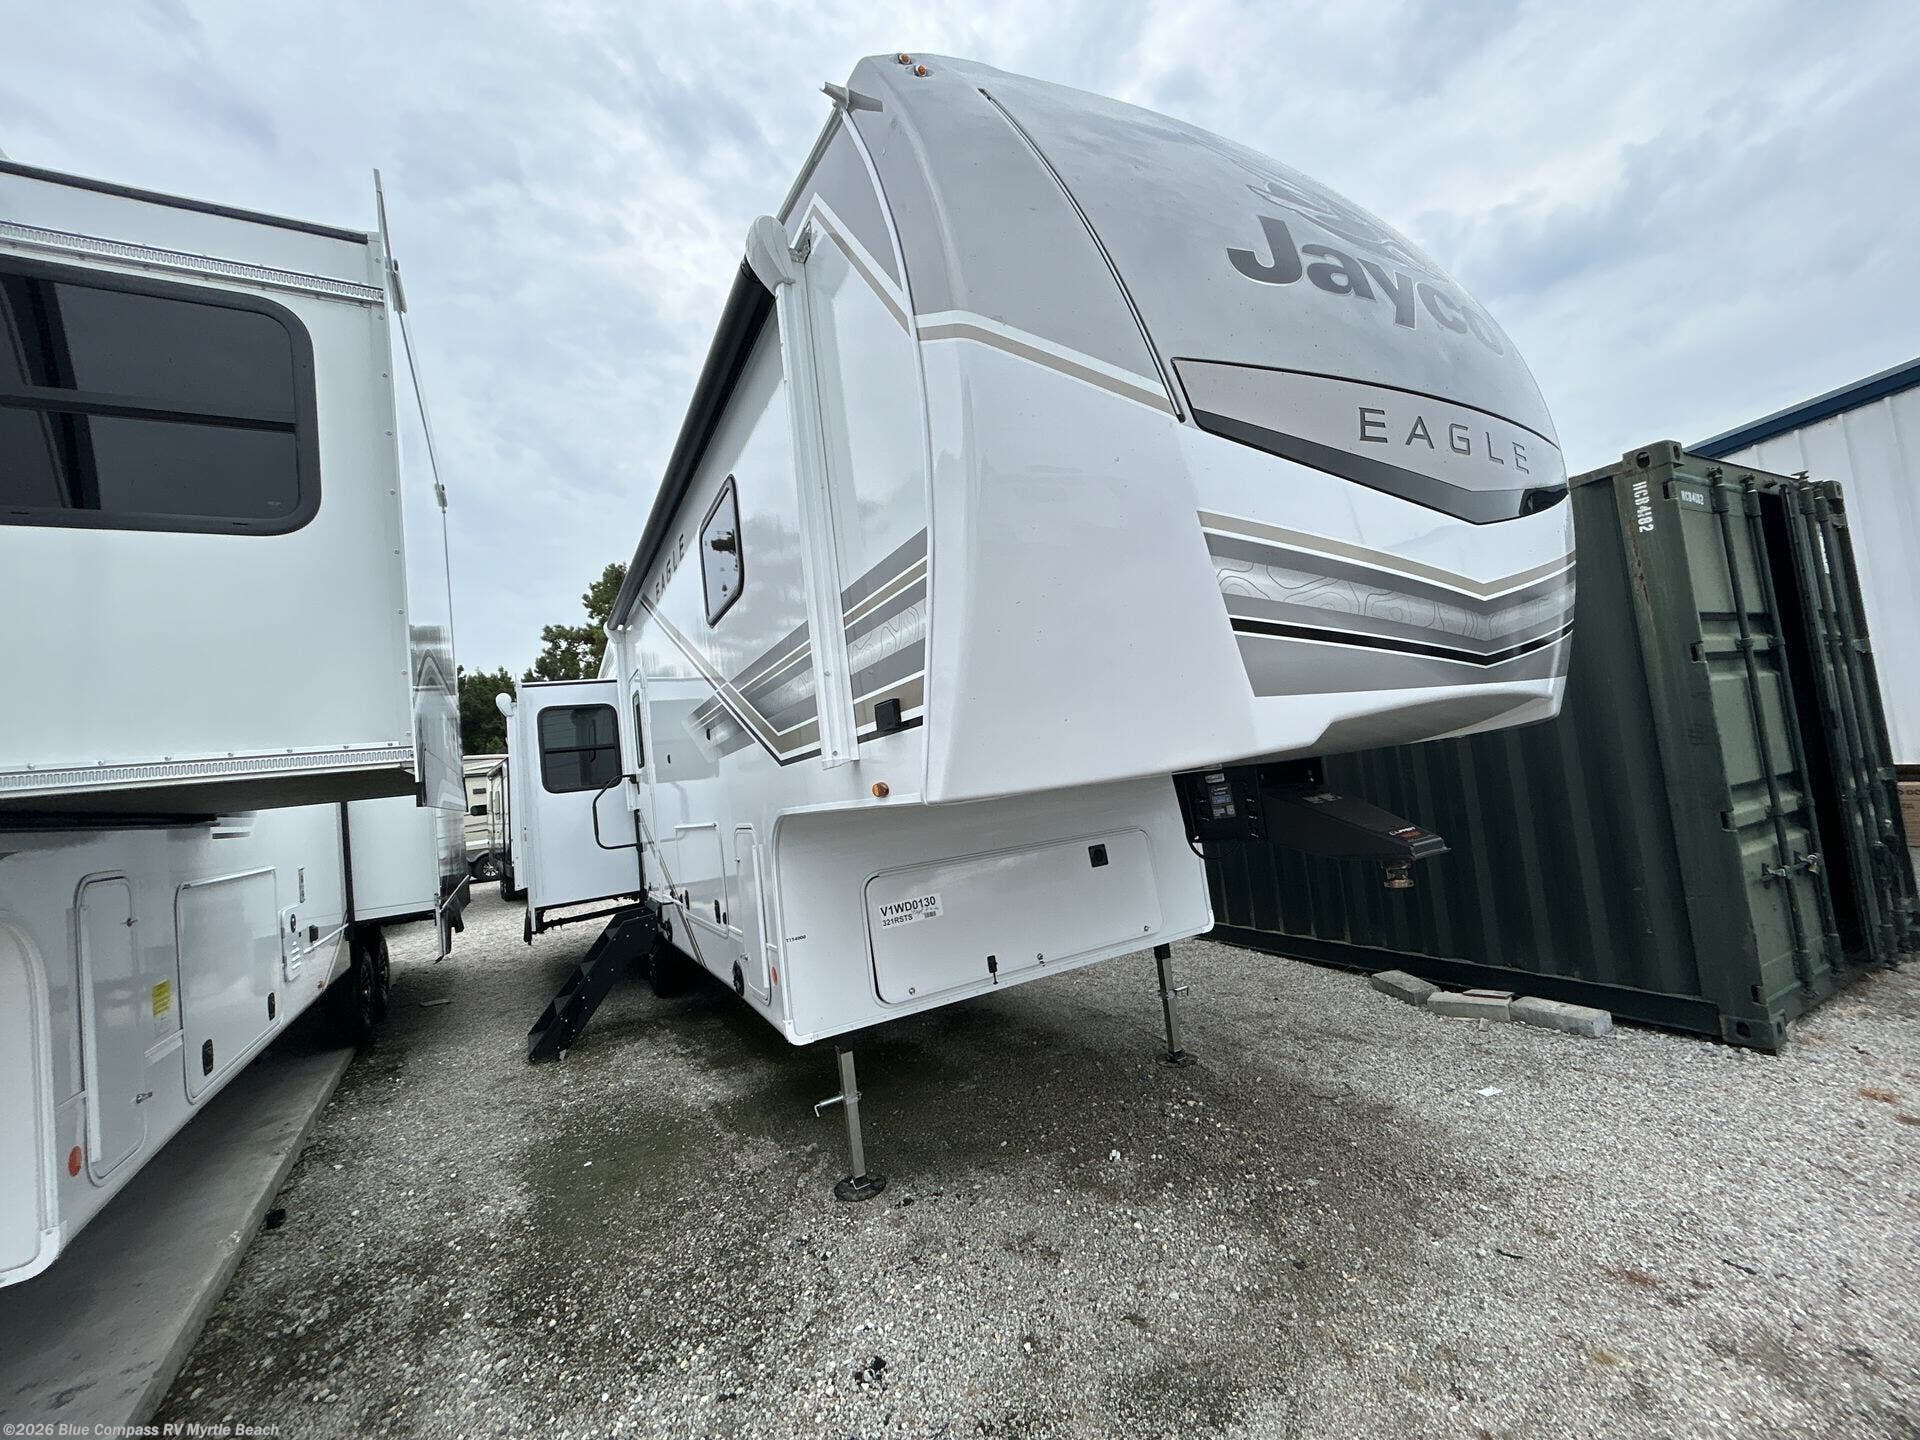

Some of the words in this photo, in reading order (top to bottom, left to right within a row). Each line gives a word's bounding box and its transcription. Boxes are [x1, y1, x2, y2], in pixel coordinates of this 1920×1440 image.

[1226, 215, 1504, 355] Jayco
[1359, 407, 1530, 474] EAGLE
[654, 533, 685, 601] EAGLE
[880, 896, 936, 917] V1WD0130
[882, 914, 913, 927] 321RSTS
